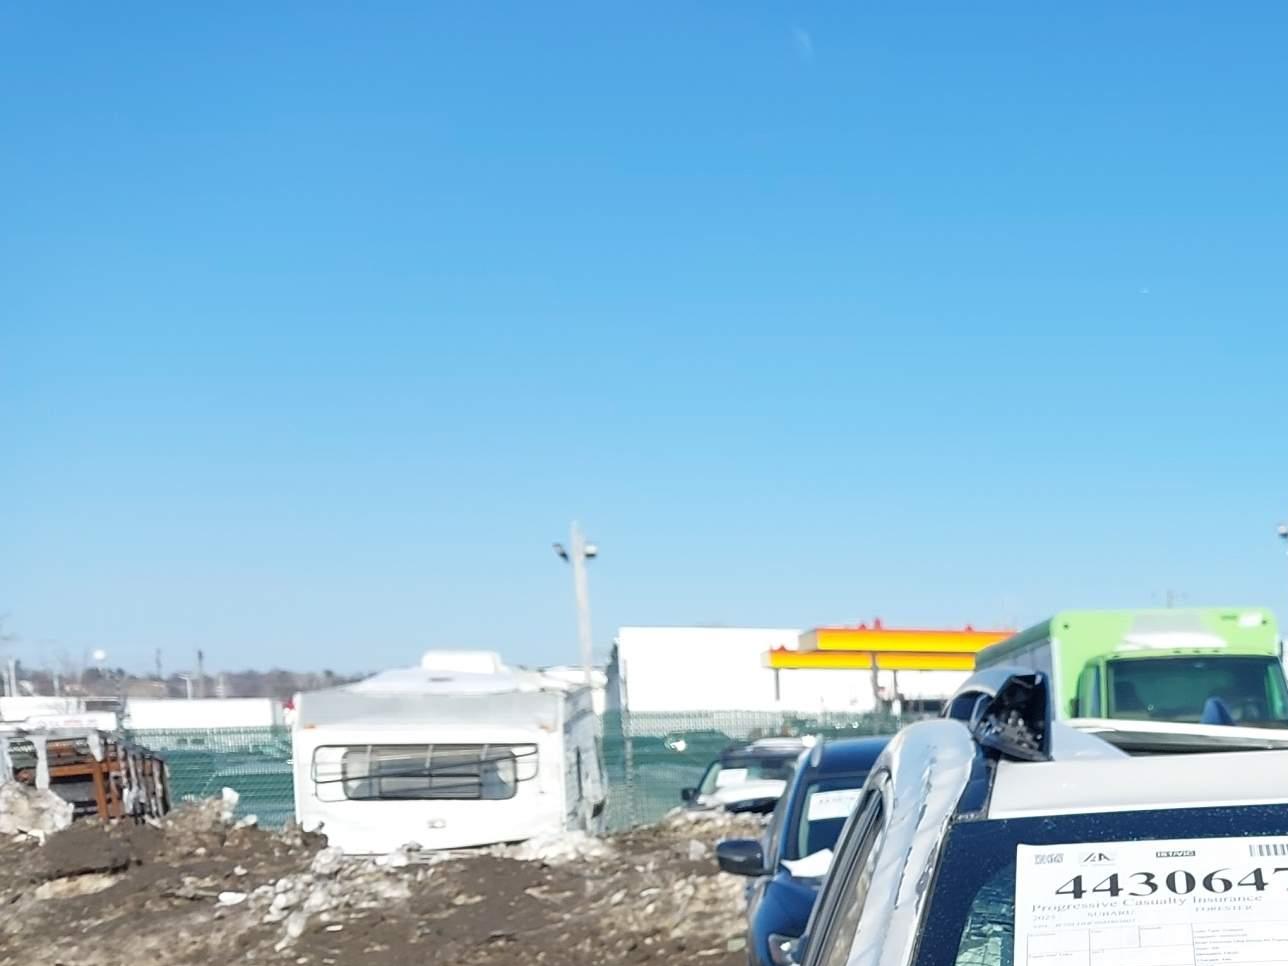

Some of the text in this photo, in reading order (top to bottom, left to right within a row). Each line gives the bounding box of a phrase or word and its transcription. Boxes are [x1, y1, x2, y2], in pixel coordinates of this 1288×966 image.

[1032, 895, 1263, 913] Progressive Casualty Insurance
